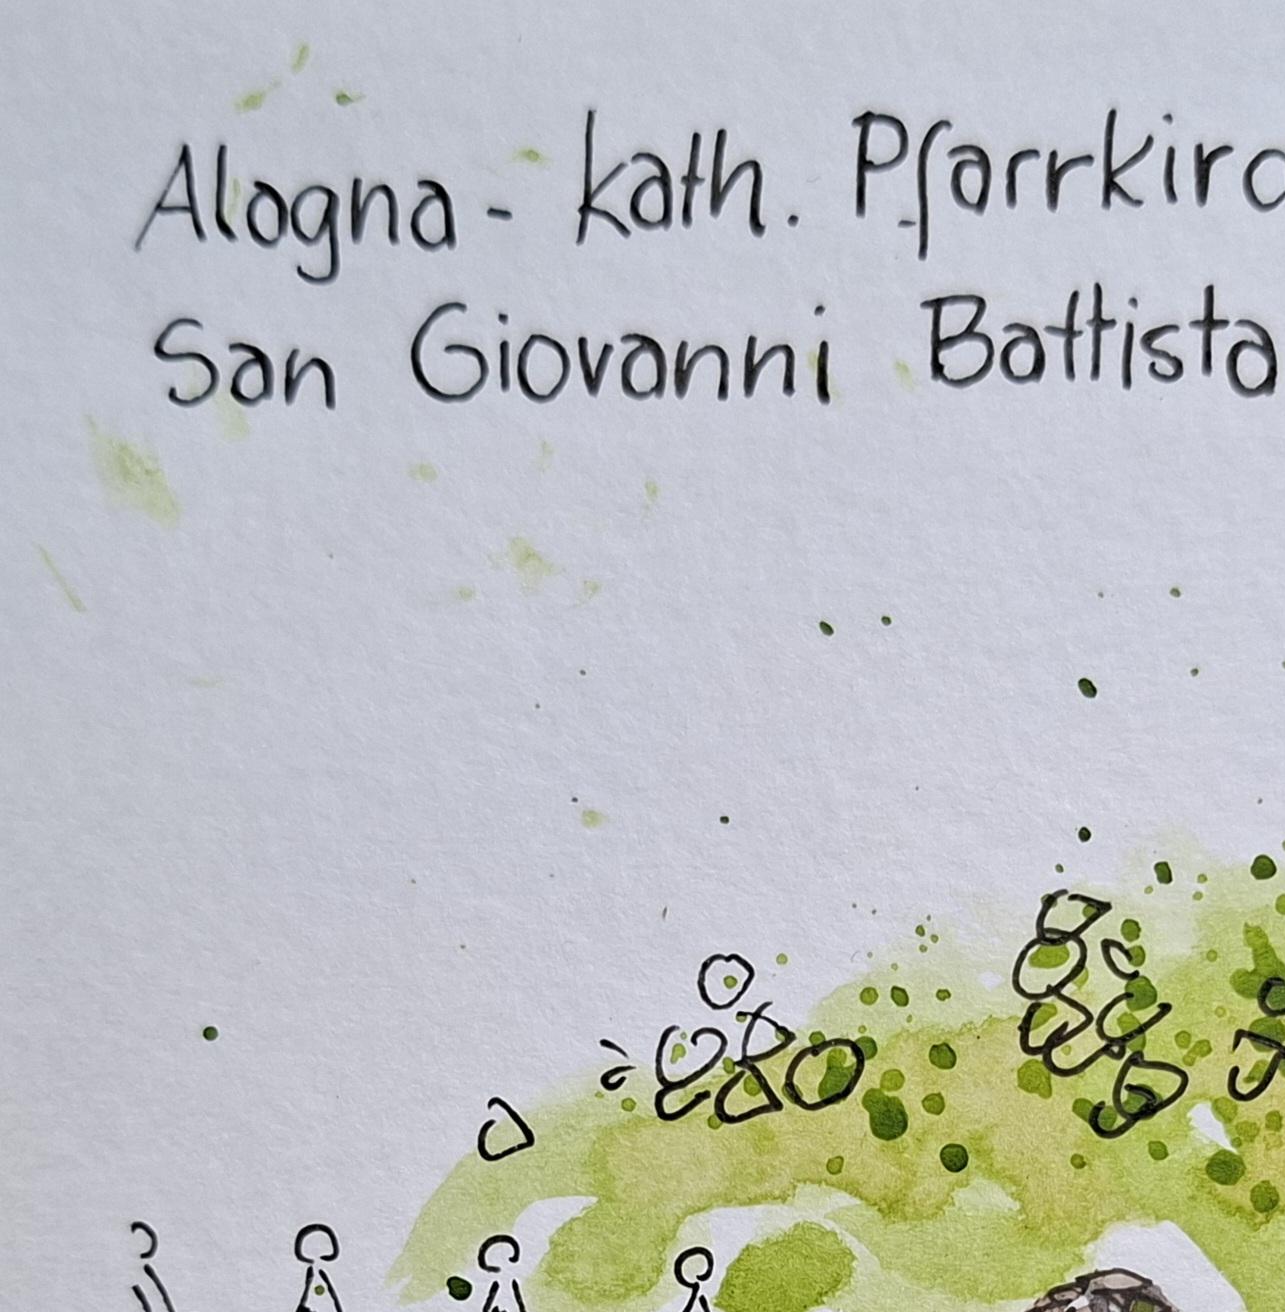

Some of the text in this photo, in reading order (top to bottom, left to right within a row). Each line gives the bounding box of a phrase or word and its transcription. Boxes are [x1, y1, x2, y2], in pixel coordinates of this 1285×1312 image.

[135, 143, 457, 284] Alagna
[153, 282, 1278, 410] San Giovanni Battista
